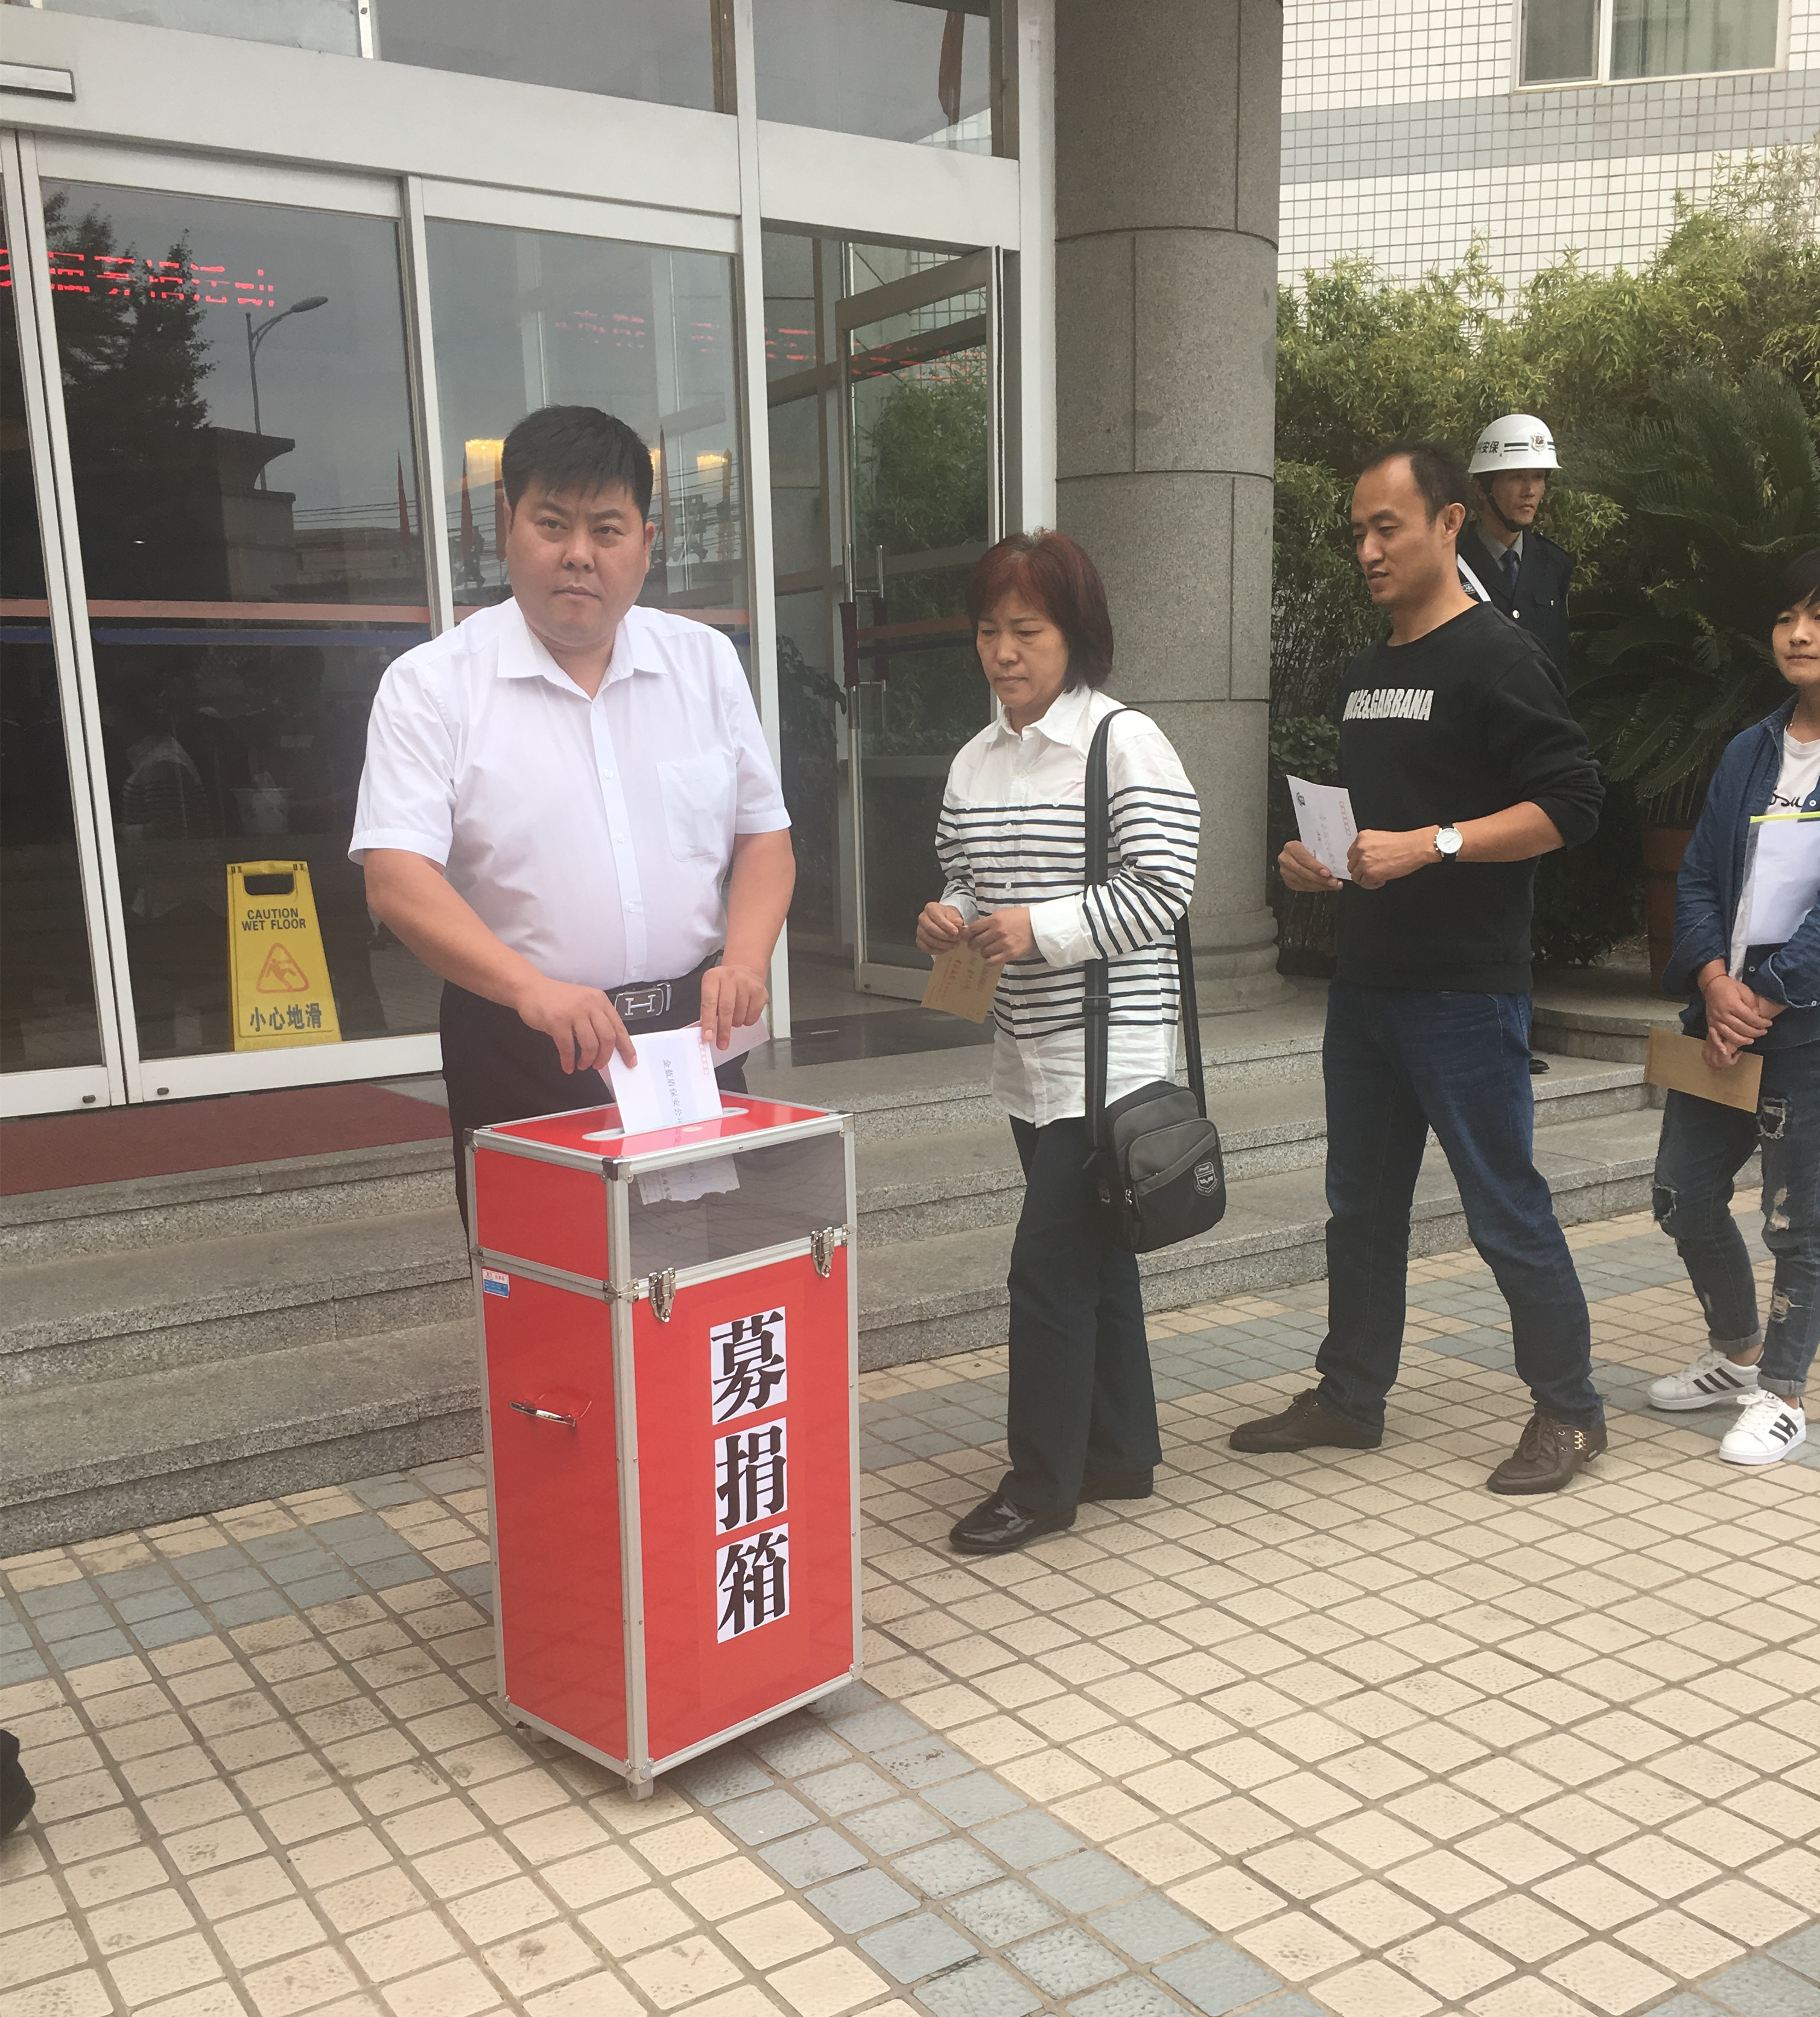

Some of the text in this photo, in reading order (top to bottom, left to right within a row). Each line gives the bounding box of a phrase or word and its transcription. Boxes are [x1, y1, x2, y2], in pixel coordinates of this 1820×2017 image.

[241, 918, 306, 931] WET FLOOR
[247, 908, 299, 920] CAUTION
[249, 1002, 322, 1033] 小心地滑
[711, 1310, 788, 1636] 募捐箱
